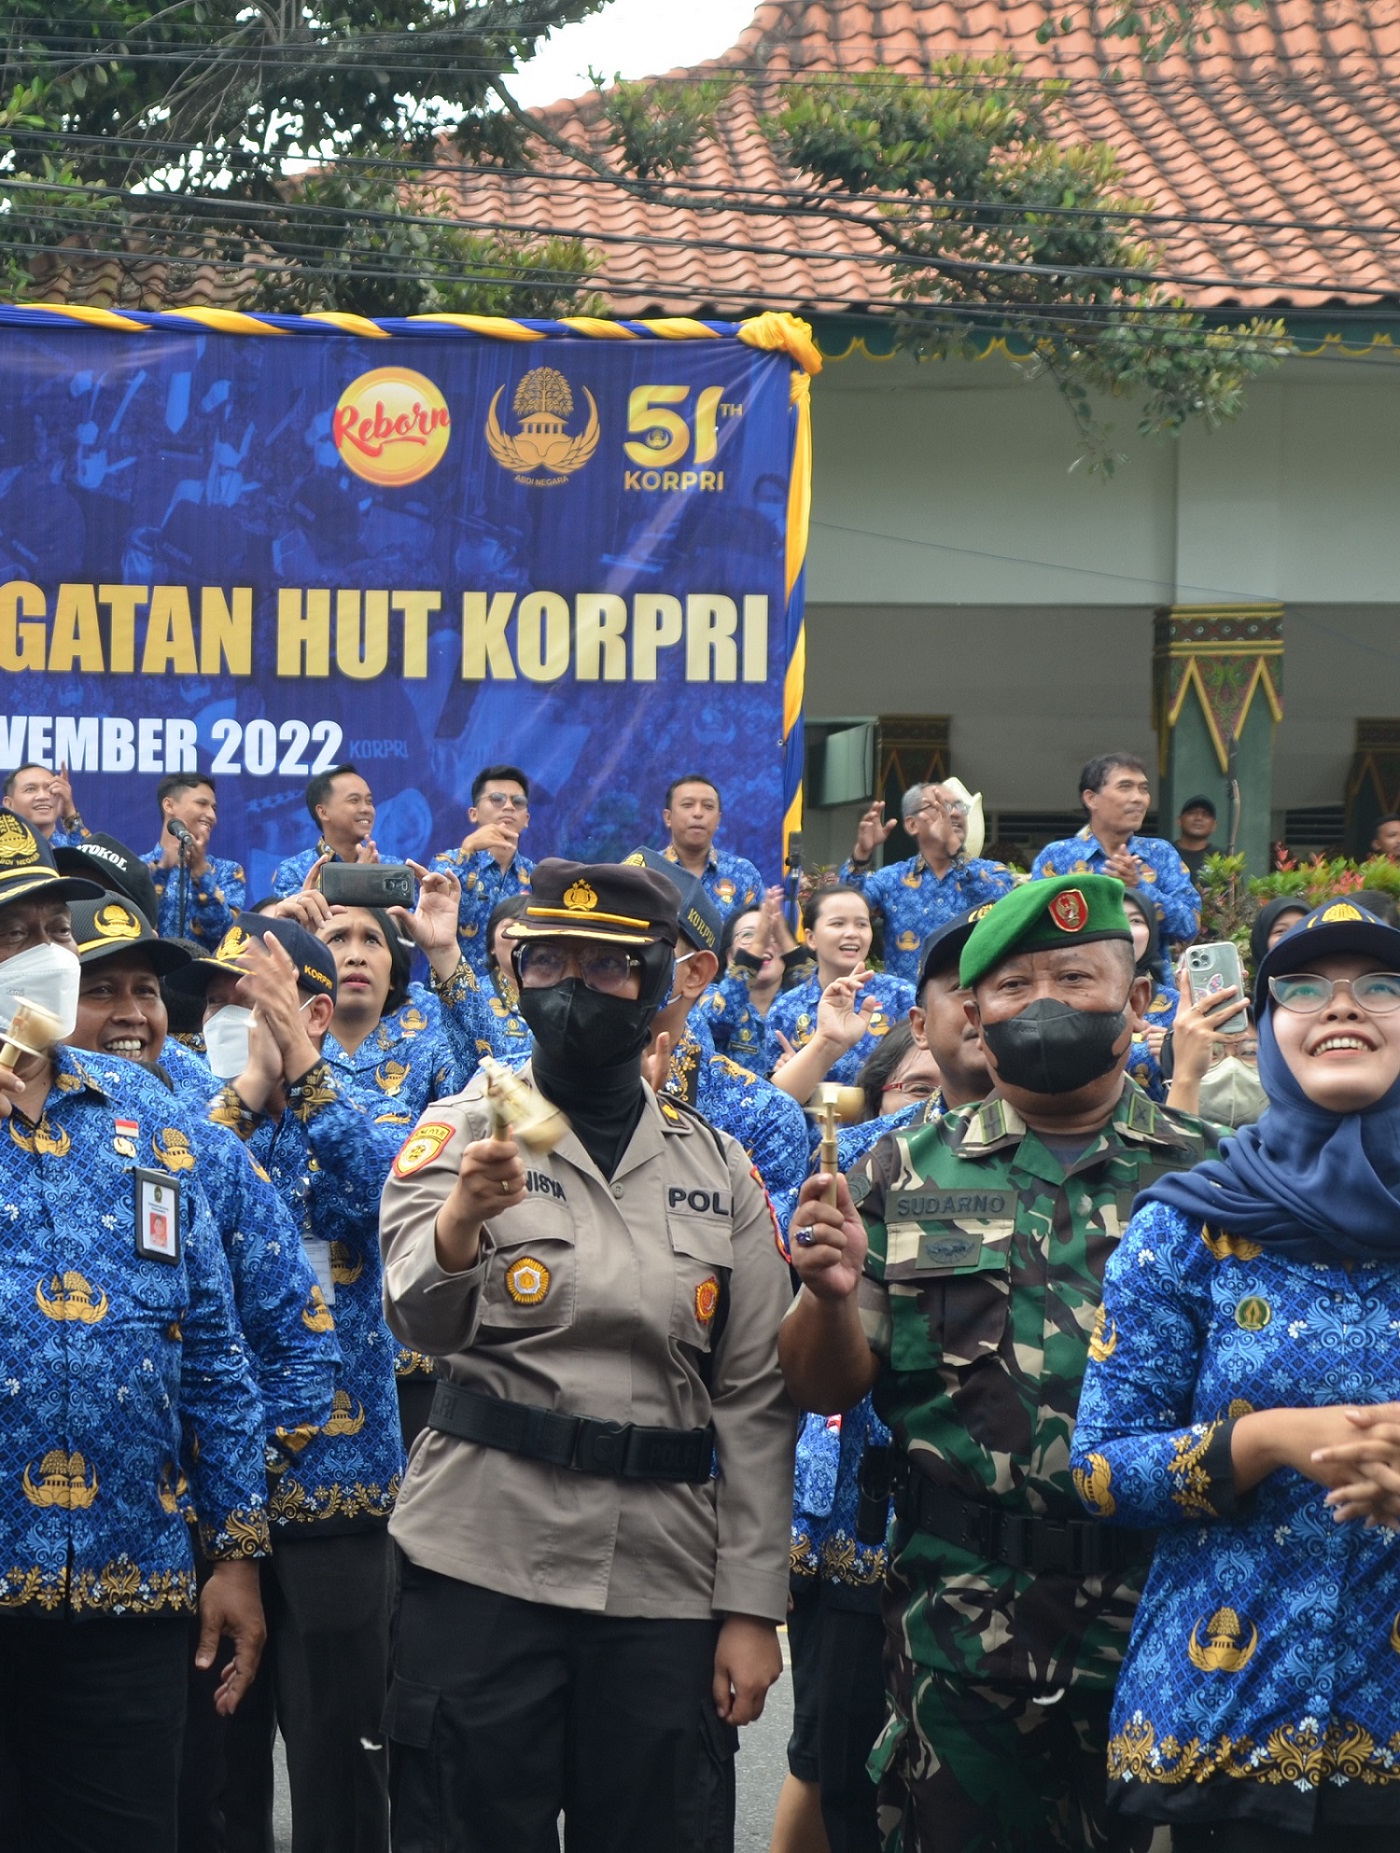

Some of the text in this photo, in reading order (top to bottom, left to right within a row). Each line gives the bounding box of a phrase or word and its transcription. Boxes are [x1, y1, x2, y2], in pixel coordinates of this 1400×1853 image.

[333, 401, 451, 457] Reborn
[514, 474, 569, 487] ABDI NEGARA
[624, 471, 724, 491] KORPRI
[278, 588, 441, 680] HUT
[462, 591, 769, 683] KORPRI
[211, 719, 343, 774] 2022
[349, 739, 409, 760] KORPRI
[76, 843, 128, 872] TOKOL
[687, 908, 716, 948] KORPRI
[897, 1194, 1005, 1216] SUDARNO
